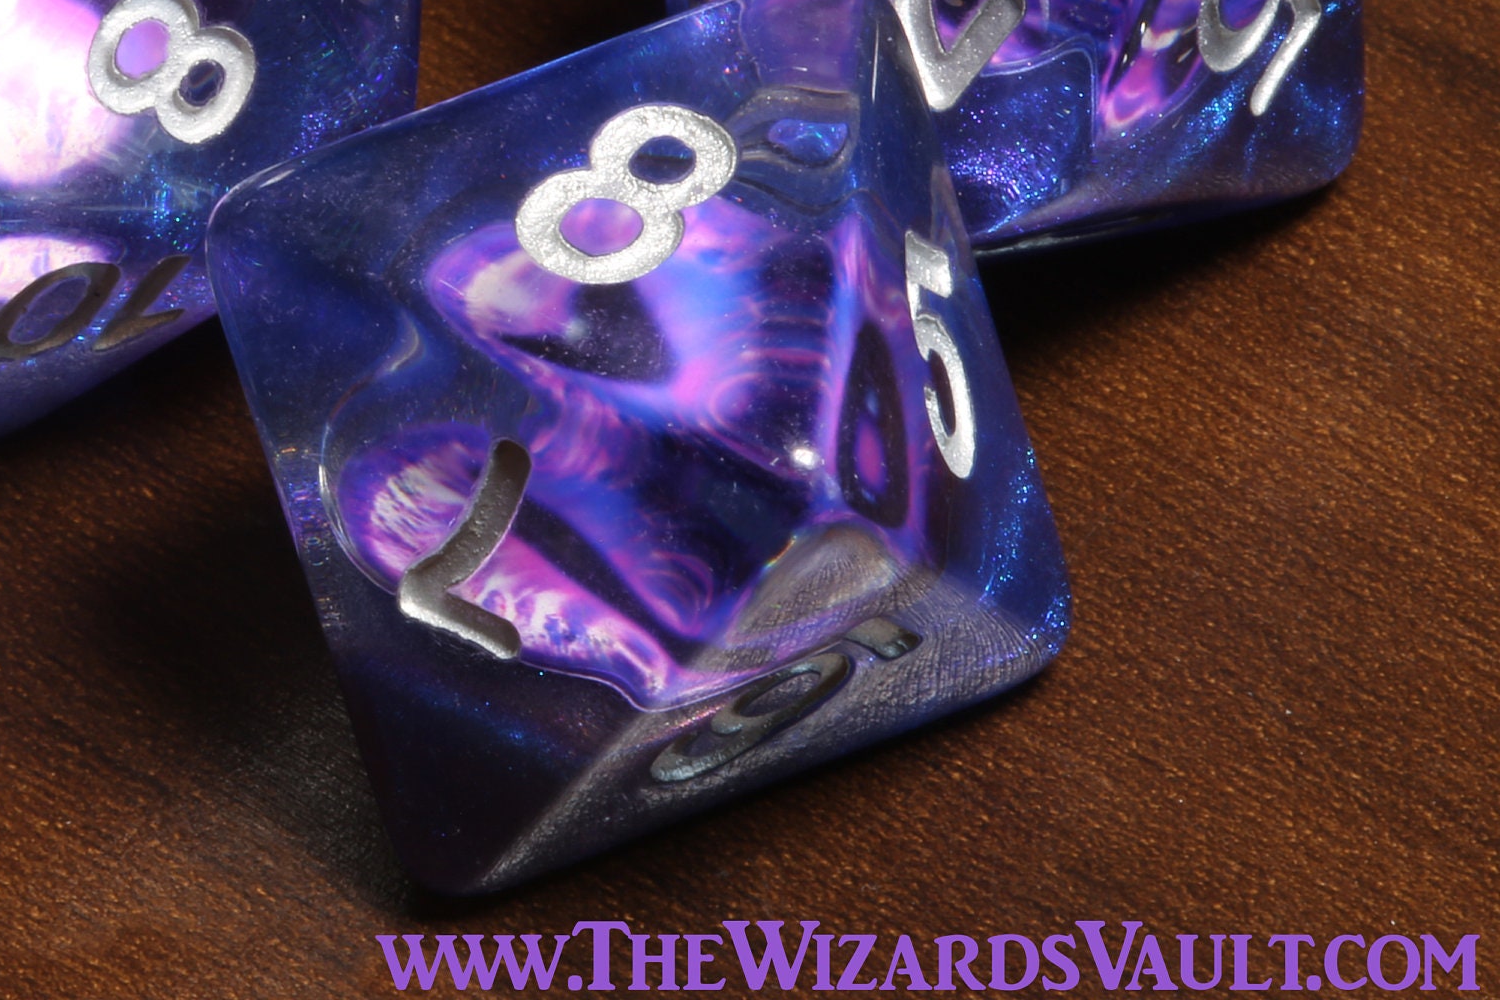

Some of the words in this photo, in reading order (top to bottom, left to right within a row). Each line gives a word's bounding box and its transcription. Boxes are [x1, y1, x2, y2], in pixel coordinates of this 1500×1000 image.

[515, 104, 738, 286] 8
[906, 230, 976, 479] 5
[398, 438, 533, 660] 7
